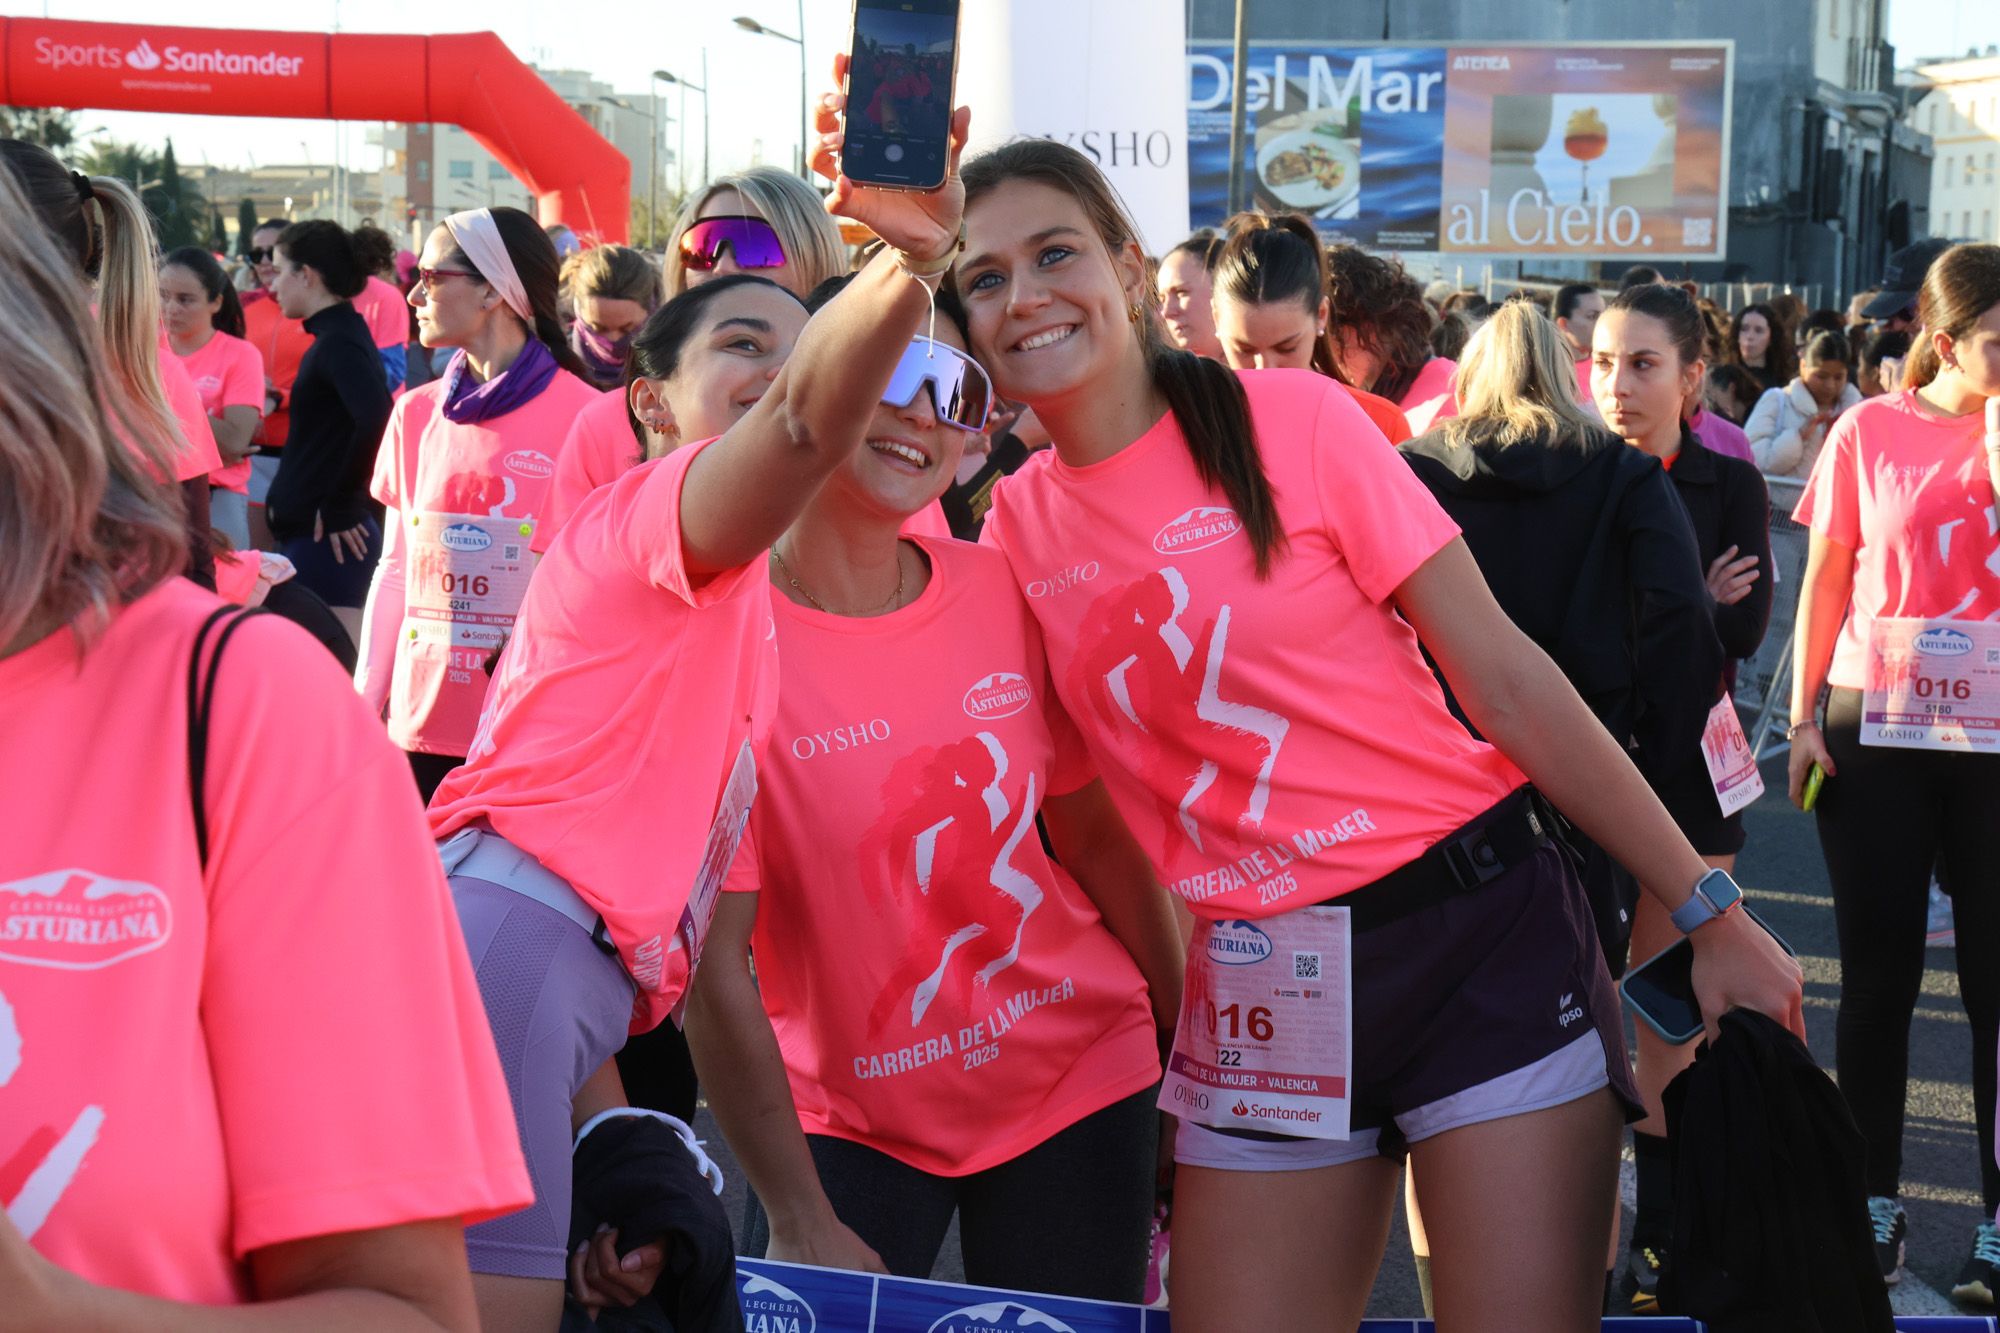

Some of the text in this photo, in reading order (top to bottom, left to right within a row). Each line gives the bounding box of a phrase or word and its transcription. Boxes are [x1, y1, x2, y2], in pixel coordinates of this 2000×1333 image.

[34, 36, 304, 77] Sports Santander
[1185, 54, 1443, 114] Del Mar
[1447, 187, 1653, 247] al Cielo.
[443, 532, 488, 546] ASTURIANA
[1160, 518, 1237, 549] ASTURIANA
[441, 572, 489, 596] 016
[1026, 560, 1100, 598] OYSHO
[1917, 638, 1970, 650] ASTURIANA
[970, 687, 1029, 713] ASTURIANA
[1915, 677, 1971, 699] 016
[792, 718, 891, 760] OYSHO
[1878, 728, 1924, 740] OYSHO
[1170, 864, 1248, 903] ARRERA
[1239, 849, 1273, 882] DE
[1292, 808, 1377, 859] MUJER
[1256, 871, 1298, 905] 2025
[1207, 937, 1266, 956] STURIANA
[853, 976, 1075, 1080] CARRERA DE LA MUJER
[1207, 1003, 1275, 1042] 016
[963, 1042, 999, 1071] 2025
[1209, 1071, 1218, 1083] LA
[1220, 1073, 1257, 1087] MUJER
[1267, 1076, 1319, 1092] VALENCIA
[1250, 1104, 1322, 1123] Santander
[745, 1300, 800, 1314] LECHERA
